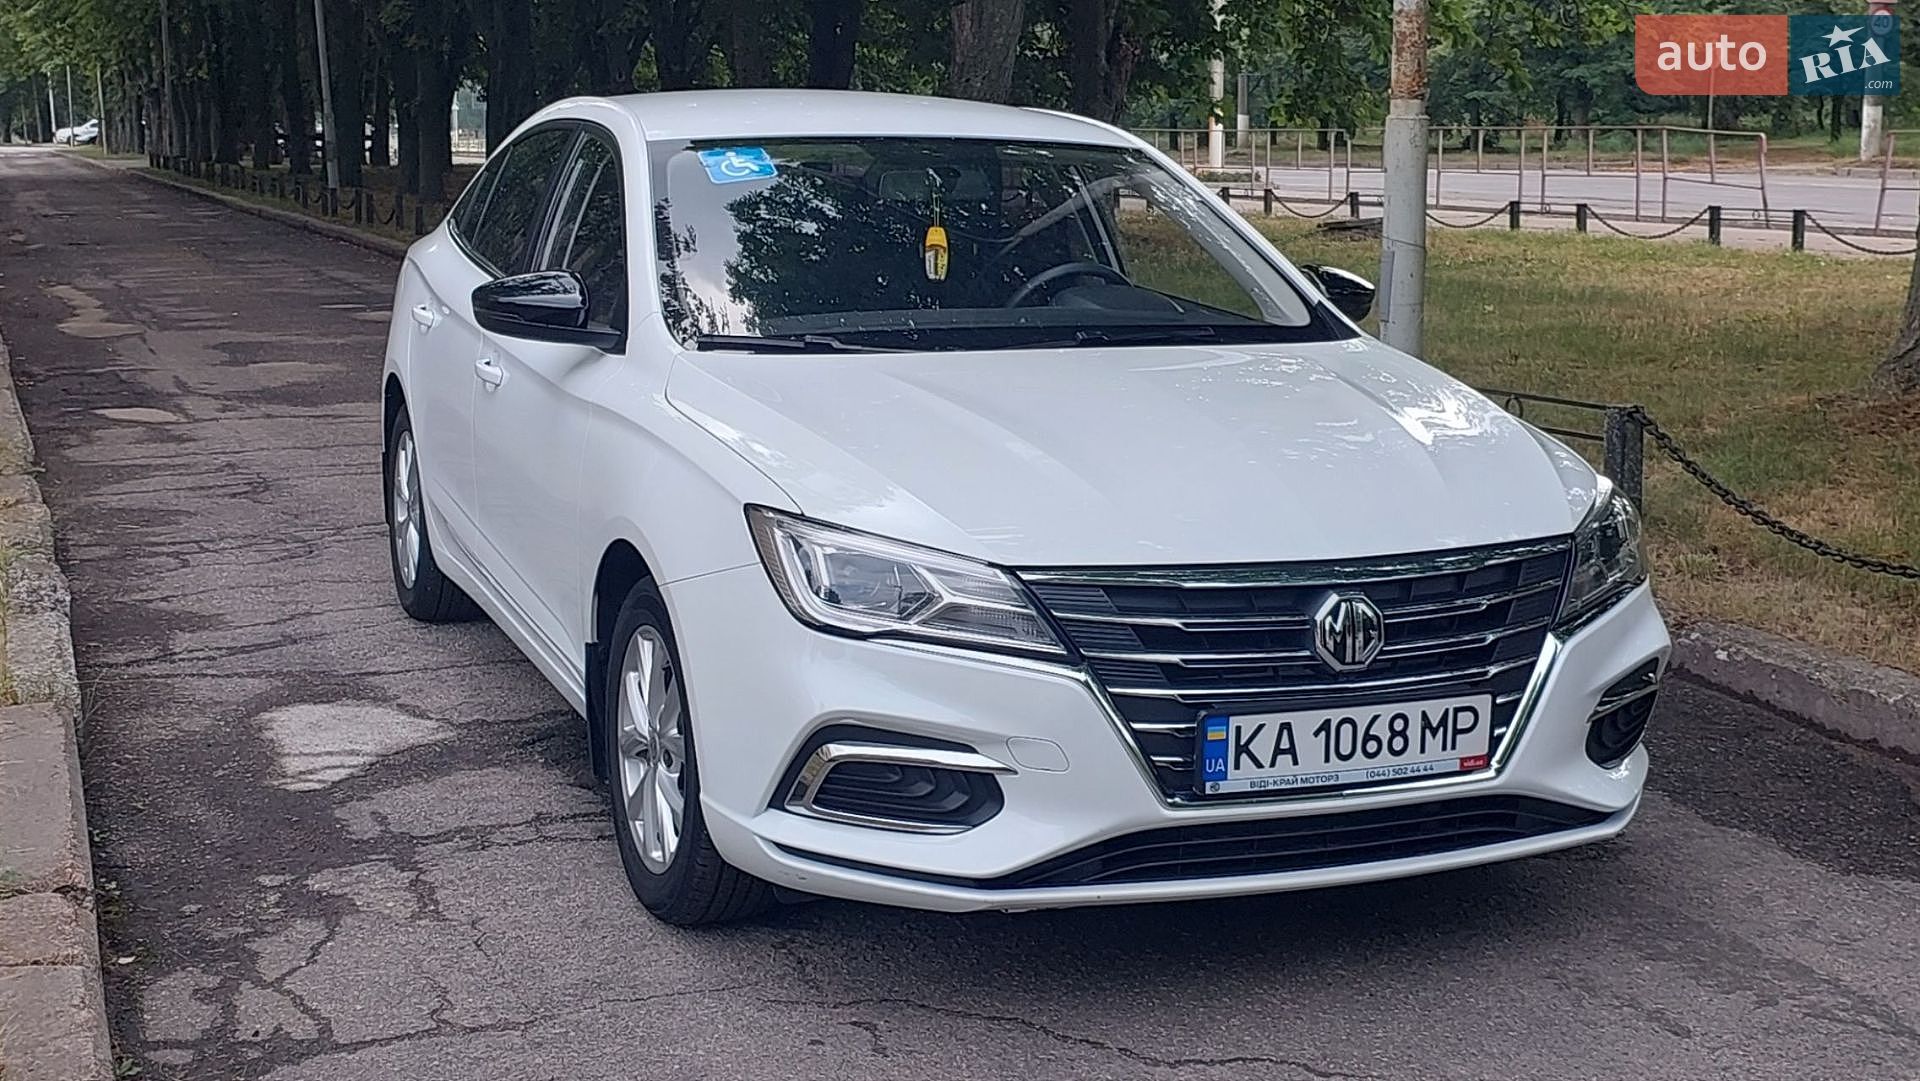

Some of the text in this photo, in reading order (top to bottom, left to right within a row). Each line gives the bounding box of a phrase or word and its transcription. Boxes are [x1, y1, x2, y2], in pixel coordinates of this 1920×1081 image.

[1324, 600, 1379, 664] MG
[1232, 705, 1480, 771] KA 1068 MP
[1205, 757, 1226, 773] UA
[1365, 764, 1434, 780] (044) 502 44 44
